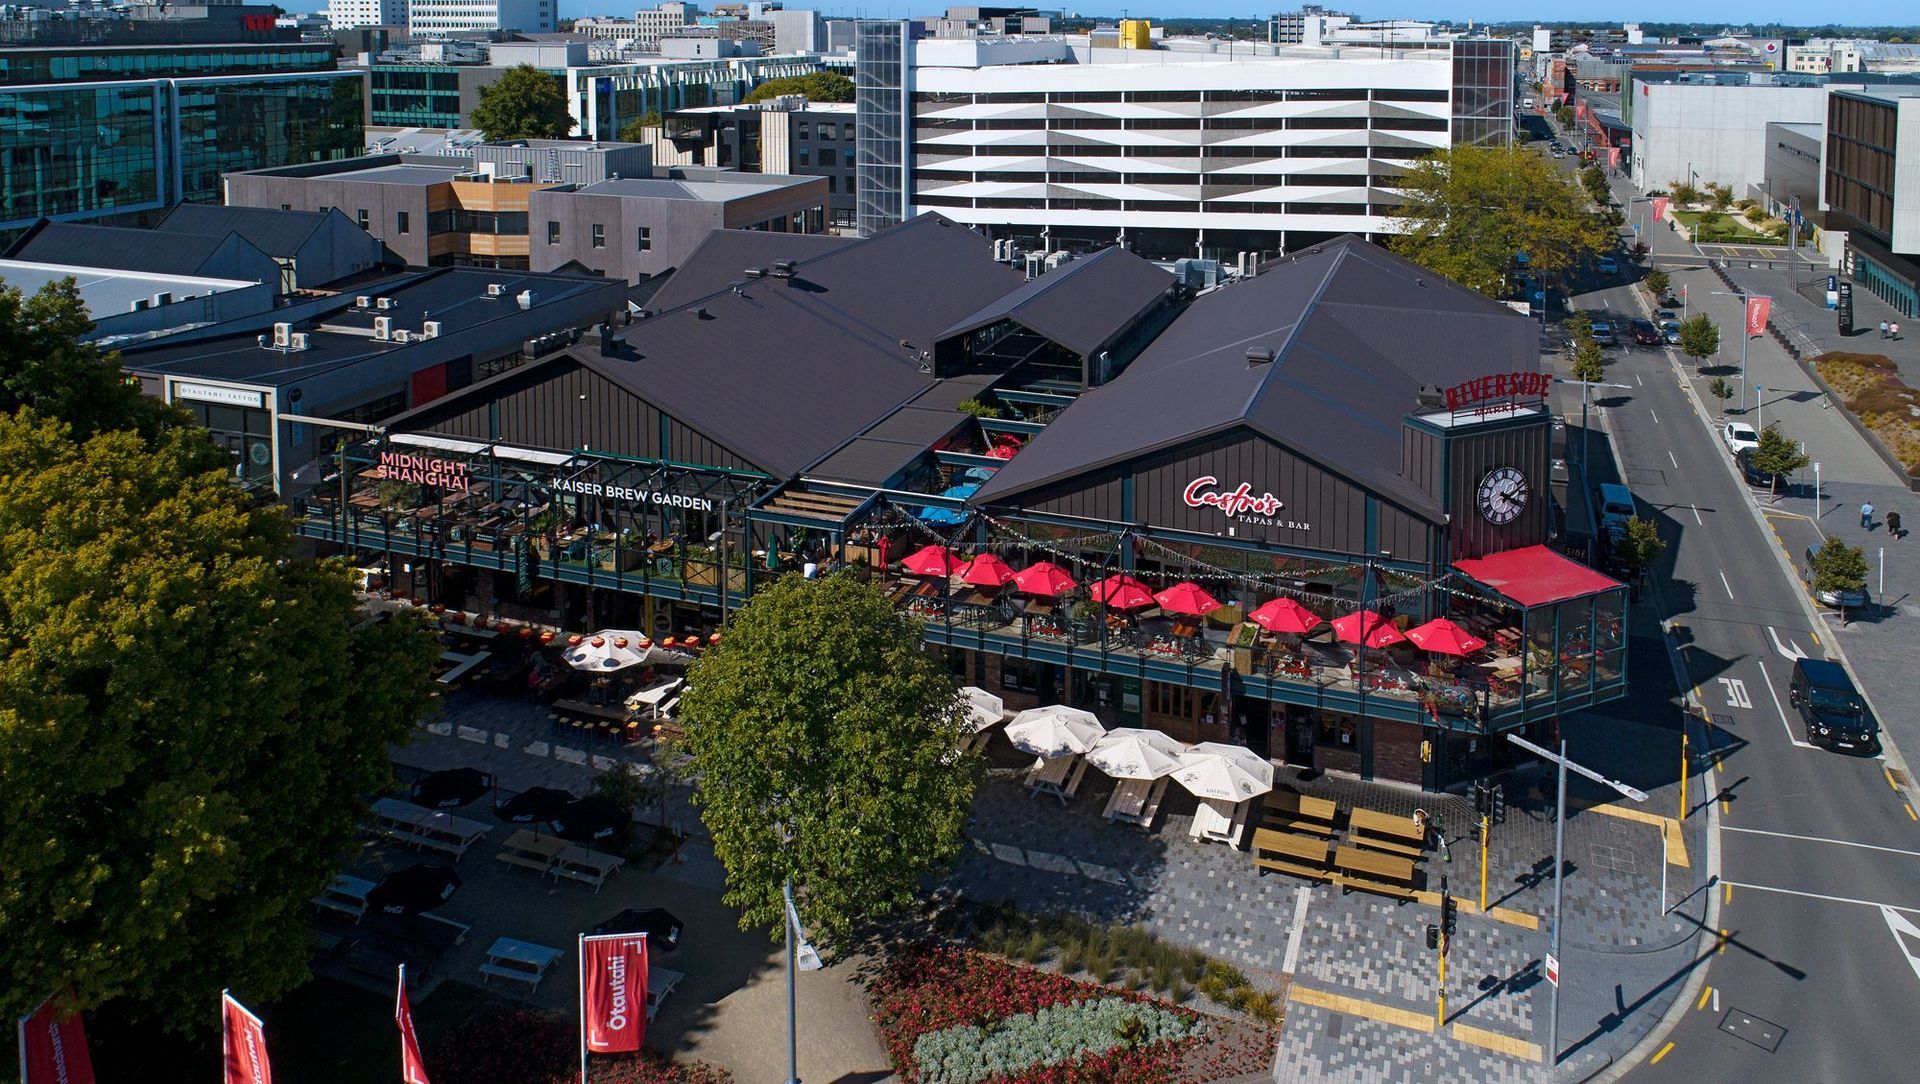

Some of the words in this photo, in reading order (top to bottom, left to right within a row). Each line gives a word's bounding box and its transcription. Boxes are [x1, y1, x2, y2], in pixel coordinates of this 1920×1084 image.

[228, 393, 259, 403] TATTOO
[1445, 371, 1553, 413] RIVERSIDE
[1474, 402, 1523, 416] MARKET
[381, 452, 467, 476] MIDNIGHT
[377, 465, 469, 492] SHANGHAI
[553, 478, 602, 496] KAISER
[606, 485, 648, 503] BREW
[652, 492, 712, 512] GARDEN
[1184, 476, 1283, 517] Castro's
[1238, 515, 1273, 526] TAPAS
[1288, 521, 1311, 531] BAR
[1718, 677, 1752, 709] 30
